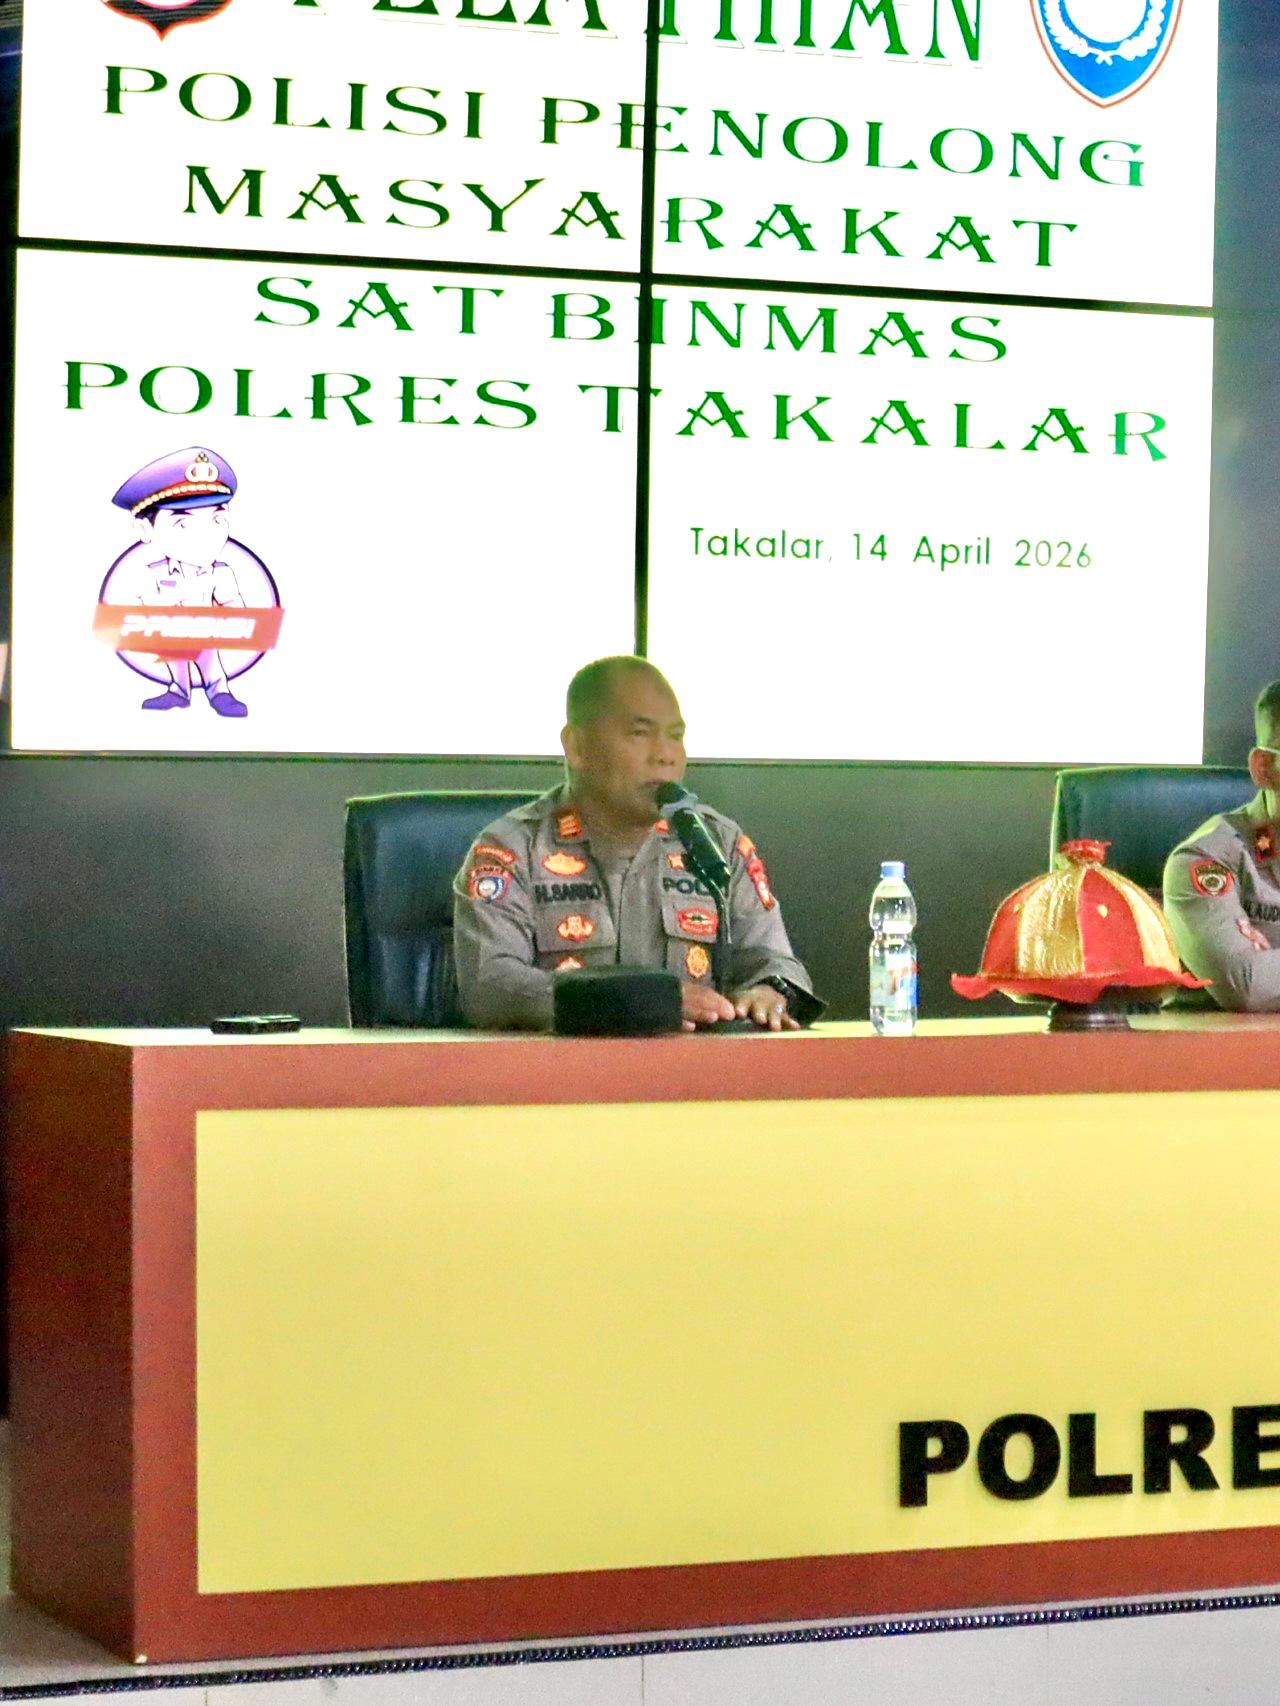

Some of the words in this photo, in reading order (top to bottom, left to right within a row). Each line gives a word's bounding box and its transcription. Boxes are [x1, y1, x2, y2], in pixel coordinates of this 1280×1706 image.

[103, 65, 486, 140] POLISI
[540, 96, 1145, 188] PENOLONG
[182, 165, 1078, 268] MASYARAKAT
[254, 276, 504, 335] SAT
[548, 292, 1008, 363] BINMAS
[63, 360, 538, 430] POLRES
[577, 383, 1168, 463] TAKALAR
[689, 526, 833, 565] Takalar,
[852, 532, 888, 562] 14
[912, 535, 991, 573] April
[1014, 538, 1093, 569] 2026
